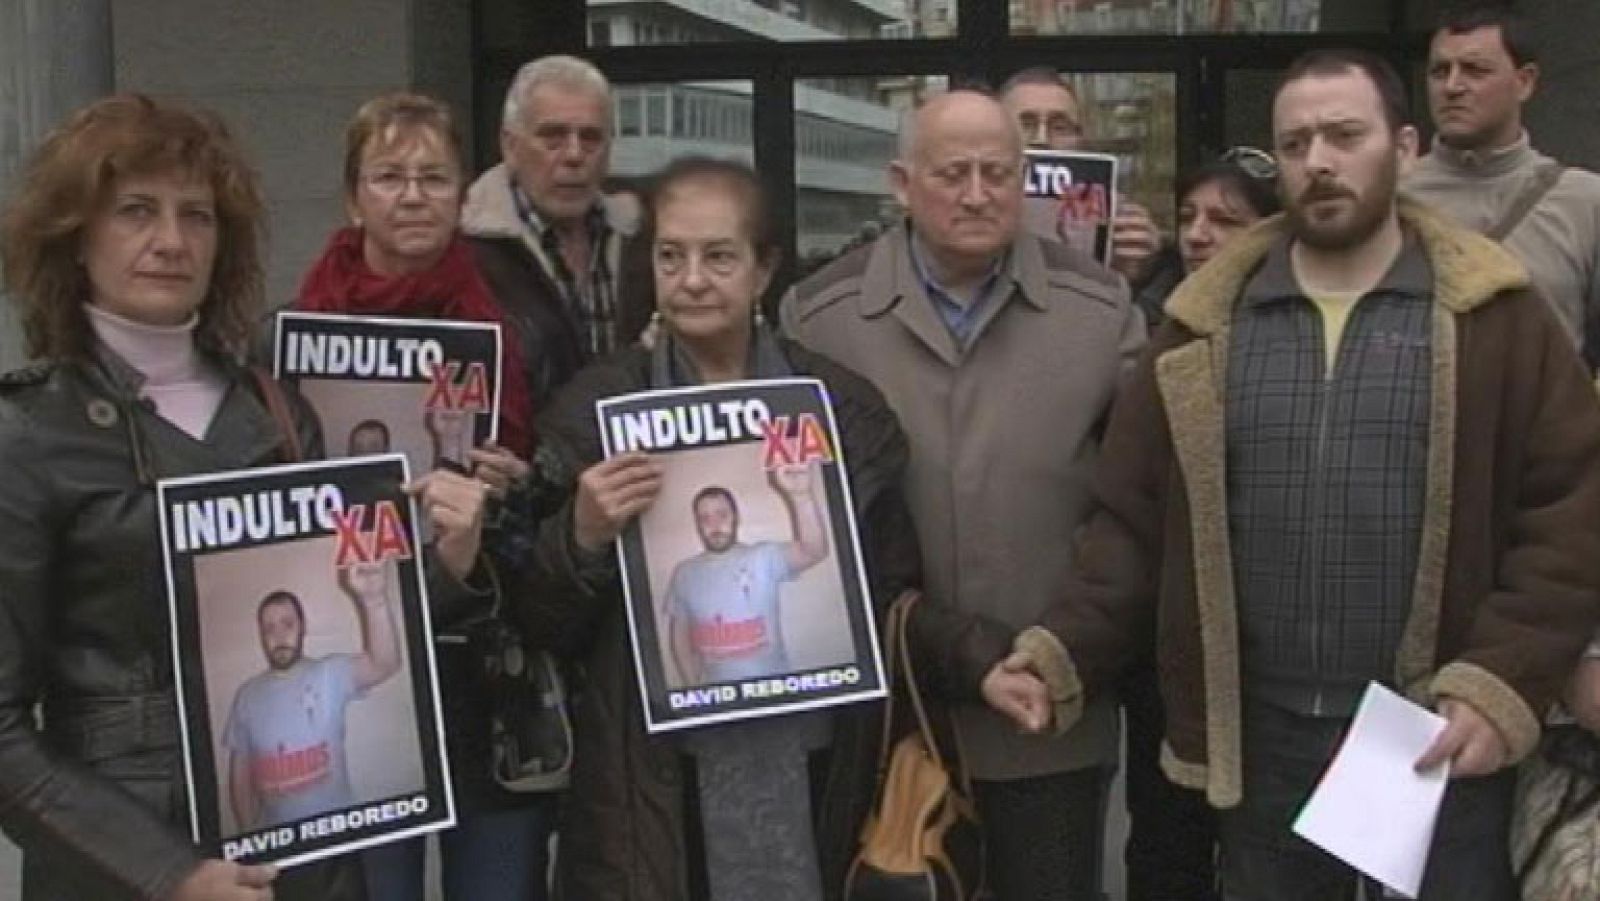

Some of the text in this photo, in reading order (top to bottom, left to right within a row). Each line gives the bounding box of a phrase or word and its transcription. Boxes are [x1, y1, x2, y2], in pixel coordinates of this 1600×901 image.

[286, 331, 490, 413] INDULTO XA
[609, 399, 837, 471] INDULTO XA
[171, 483, 413, 568] INDULTO XA
[669, 666, 861, 709] DAVID REBOREDO
[222, 795, 429, 862] DAVID REBOREDO
